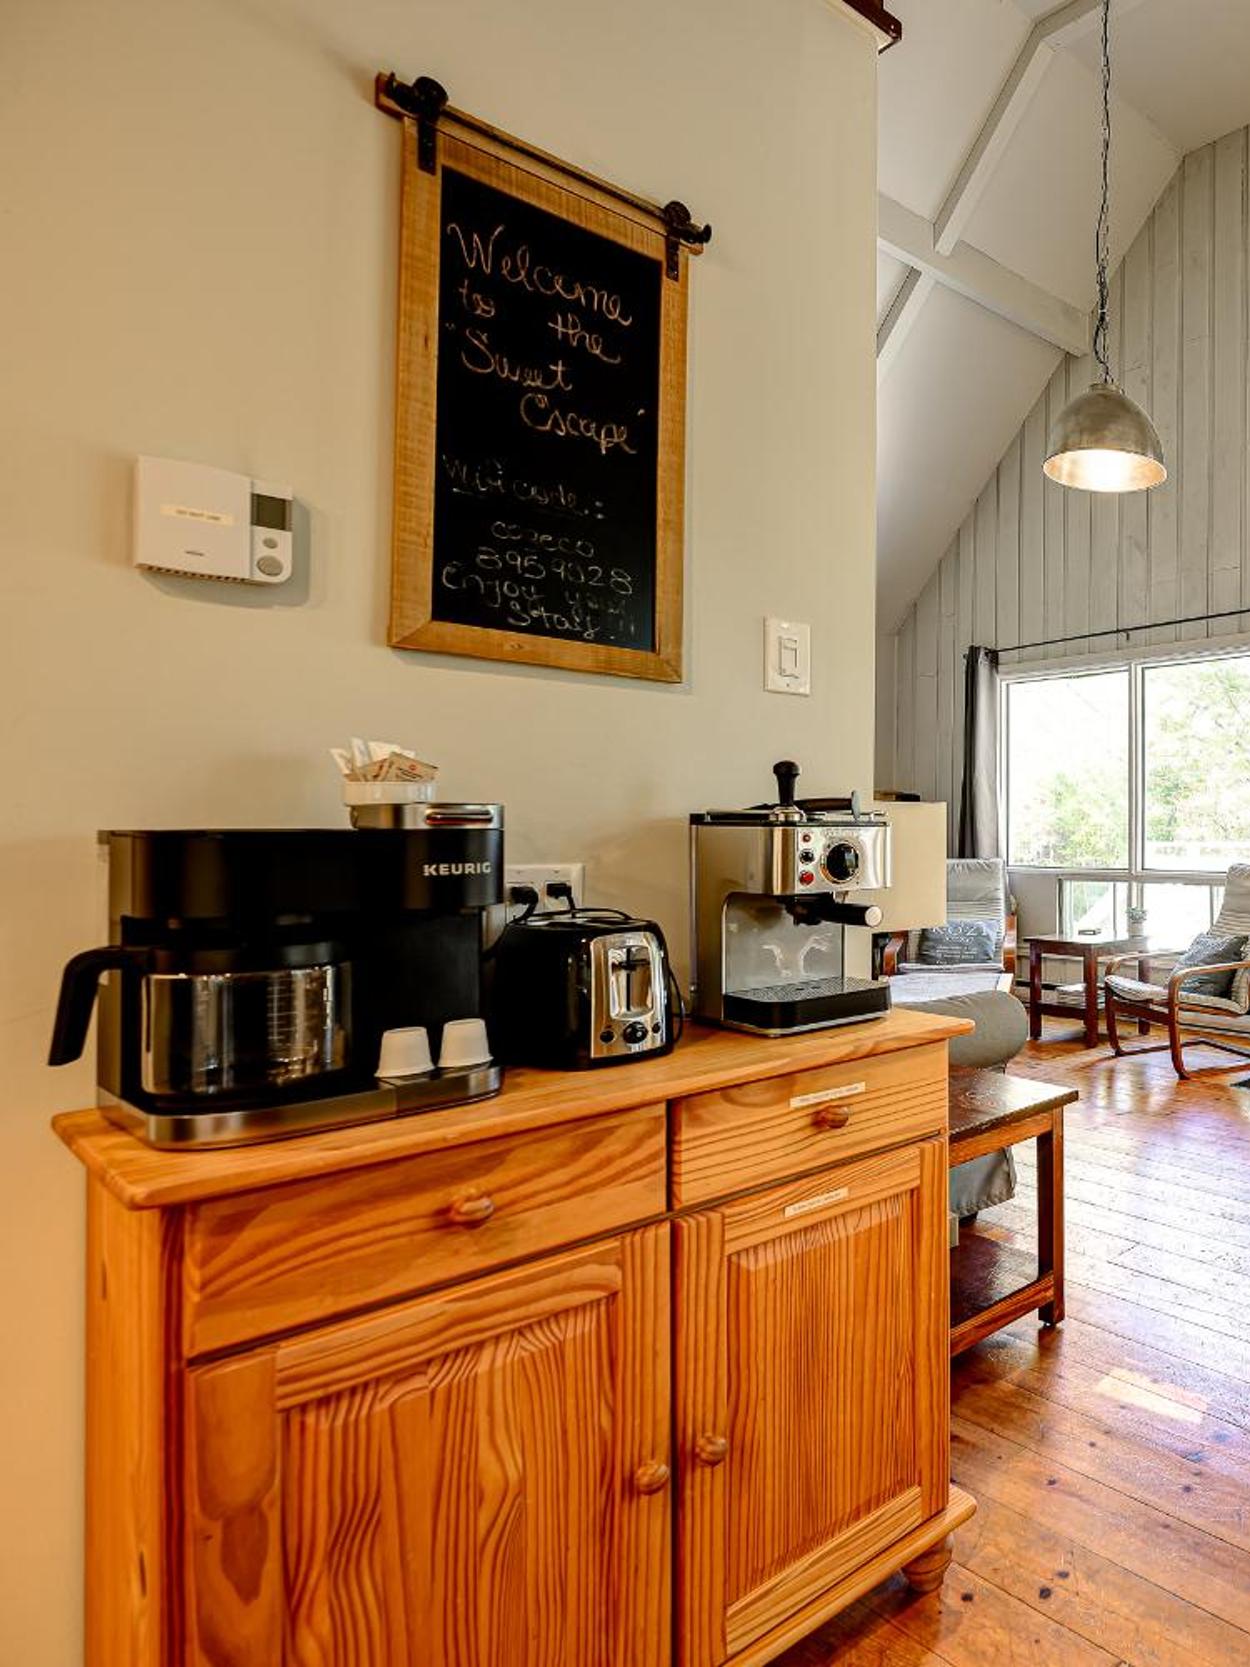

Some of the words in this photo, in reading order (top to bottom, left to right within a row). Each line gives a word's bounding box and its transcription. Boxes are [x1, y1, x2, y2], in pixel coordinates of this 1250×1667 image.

[446, 223, 632, 326] Welcome
[458, 279, 496, 318] to
[547, 312, 622, 364] the
[422, 861, 493, 877] KEURIG
